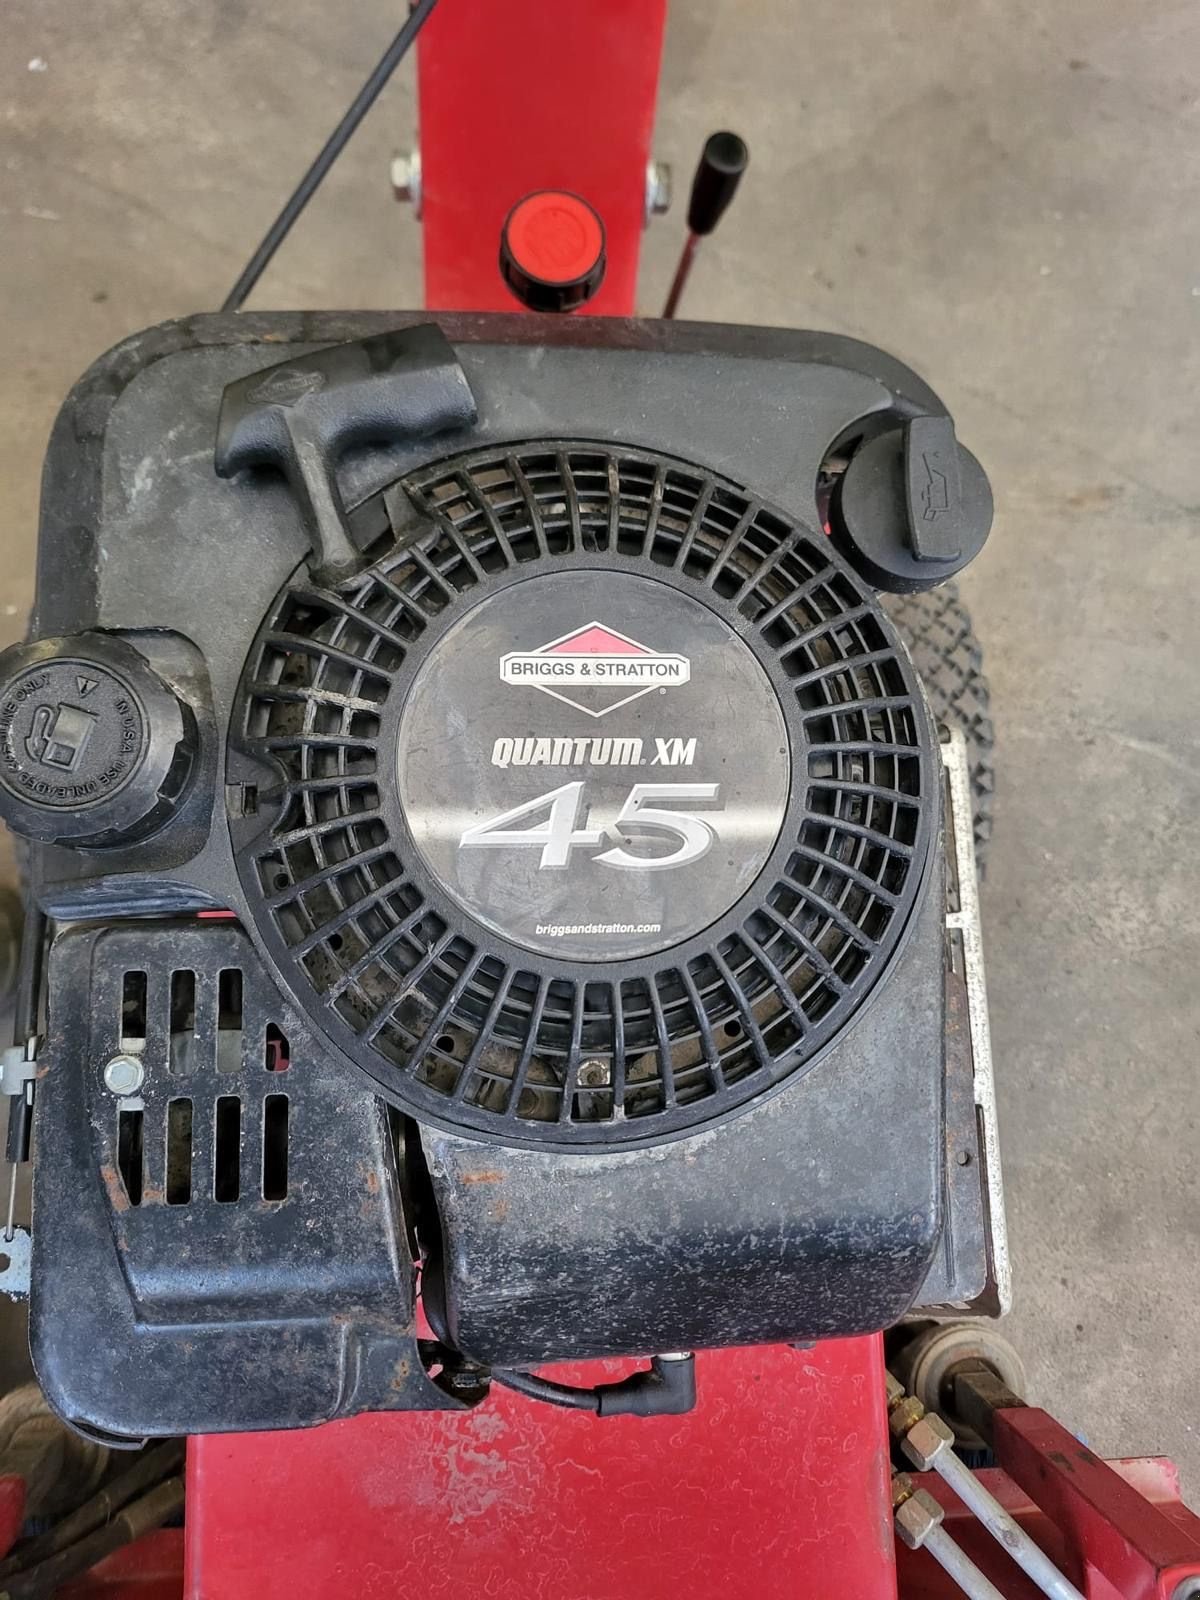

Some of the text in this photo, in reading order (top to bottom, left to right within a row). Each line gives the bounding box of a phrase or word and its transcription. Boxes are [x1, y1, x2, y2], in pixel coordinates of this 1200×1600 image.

[511, 662, 680, 677] BRIGGS & STRATTON
[15, 673, 50, 702] ONLY
[491, 737, 697, 769] QUANTUM XM
[19, 771, 97, 799] UNLEADED
[99, 760, 126, 786] USE
[458, 781, 722, 872] 45
[535, 923, 661, 937] briggsandstratton.com
